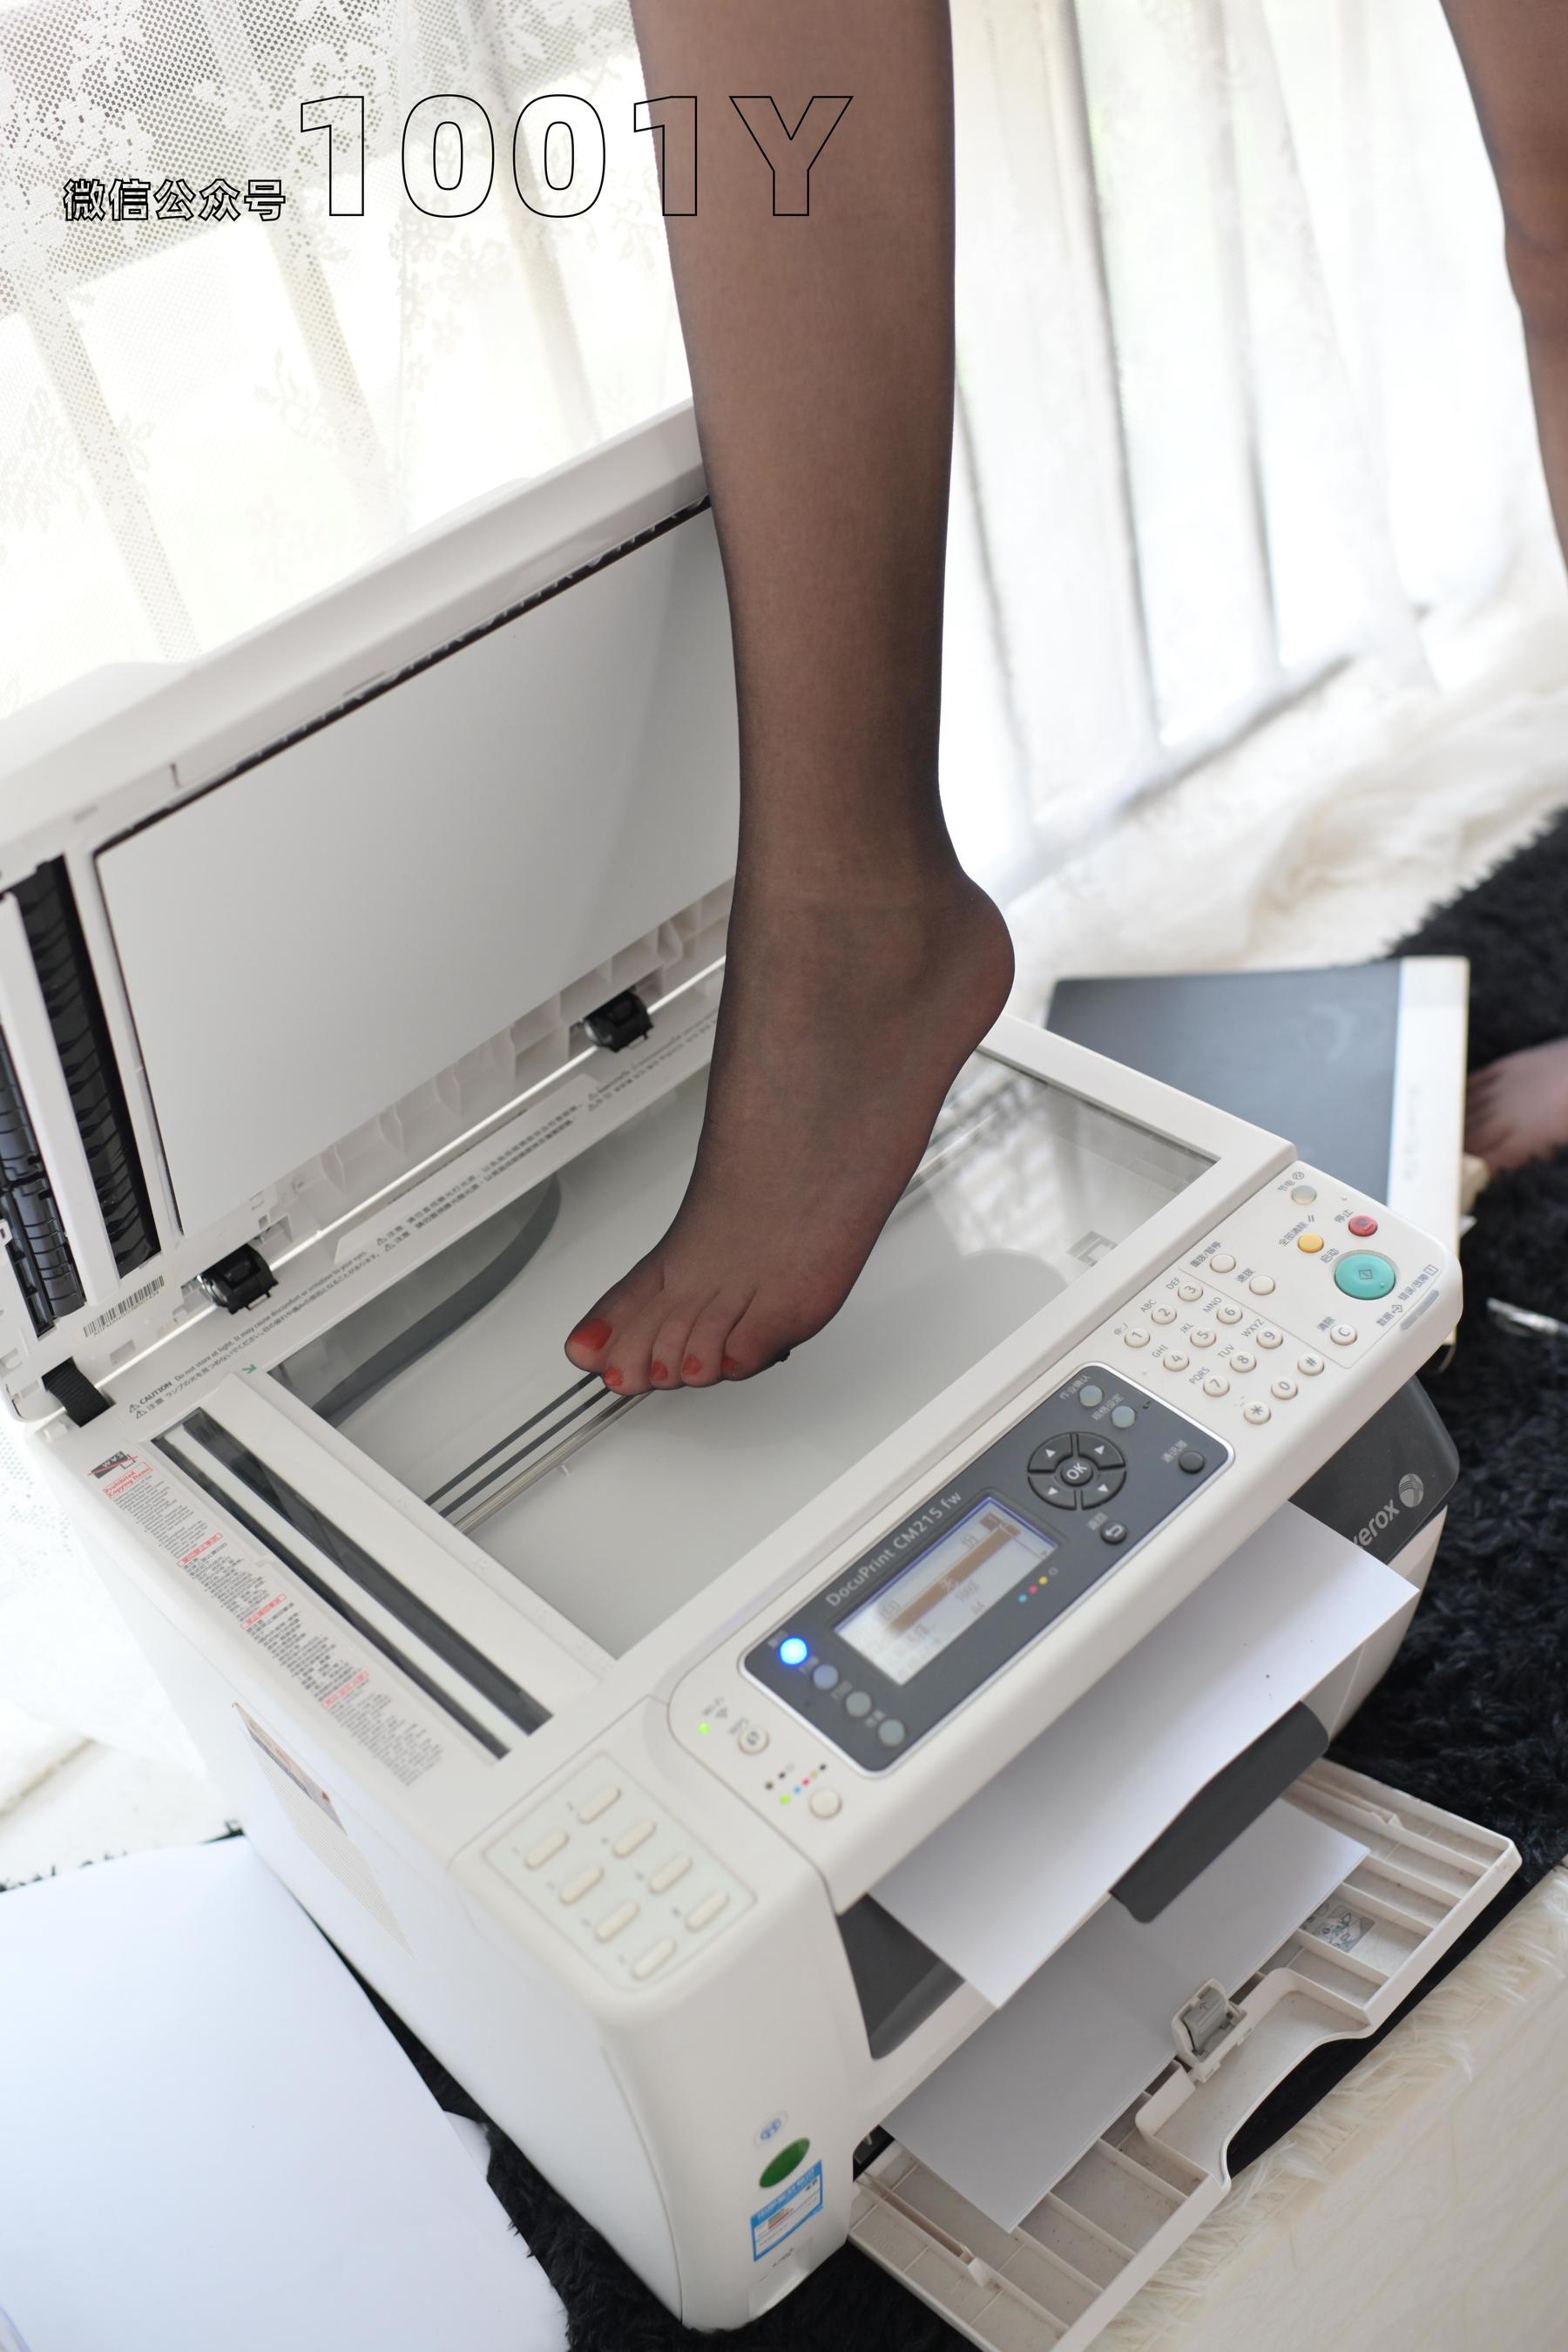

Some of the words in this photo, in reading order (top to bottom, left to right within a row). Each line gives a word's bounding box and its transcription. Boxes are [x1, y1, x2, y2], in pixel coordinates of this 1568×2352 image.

[1321, 1247, 1340, 1263] 启动
[1165, 1276, 1182, 1290] DEF
[1184, 1285, 1196, 1294] 3
[1140, 1299, 1158, 1313] ABC
[1203, 1296, 1223, 1314] MNO
[1224, 1308, 1236, 1316] 6
[1159, 1308, 1171, 1317] 2
[1179, 1321, 1193, 1334] JKL
[1241, 1318, 1264, 1338] WXYZ
[1338, 1327, 1351, 1337] C
[1197, 1330, 1209, 1340] 5
[1264, 1331, 1275, 1340] 9
[1152, 1344, 1169, 1358] GHI
[1217, 1344, 1235, 1359] TUV
[1237, 1355, 1249, 1364] 8
[1189, 1367, 1211, 1384] PQRS
[1209, 1378, 1220, 1389] 7
[1279, 1381, 1291, 1391] 0
[139, 1381, 172, 1405] CAUTION
[1065, 1462, 1088, 1480] OK
[105, 1470, 136, 1493] Prohibited
[825, 1548, 896, 1607] DocuPrint
[893, 1506, 943, 1551] CM215
[941, 1490, 963, 1510] fw
